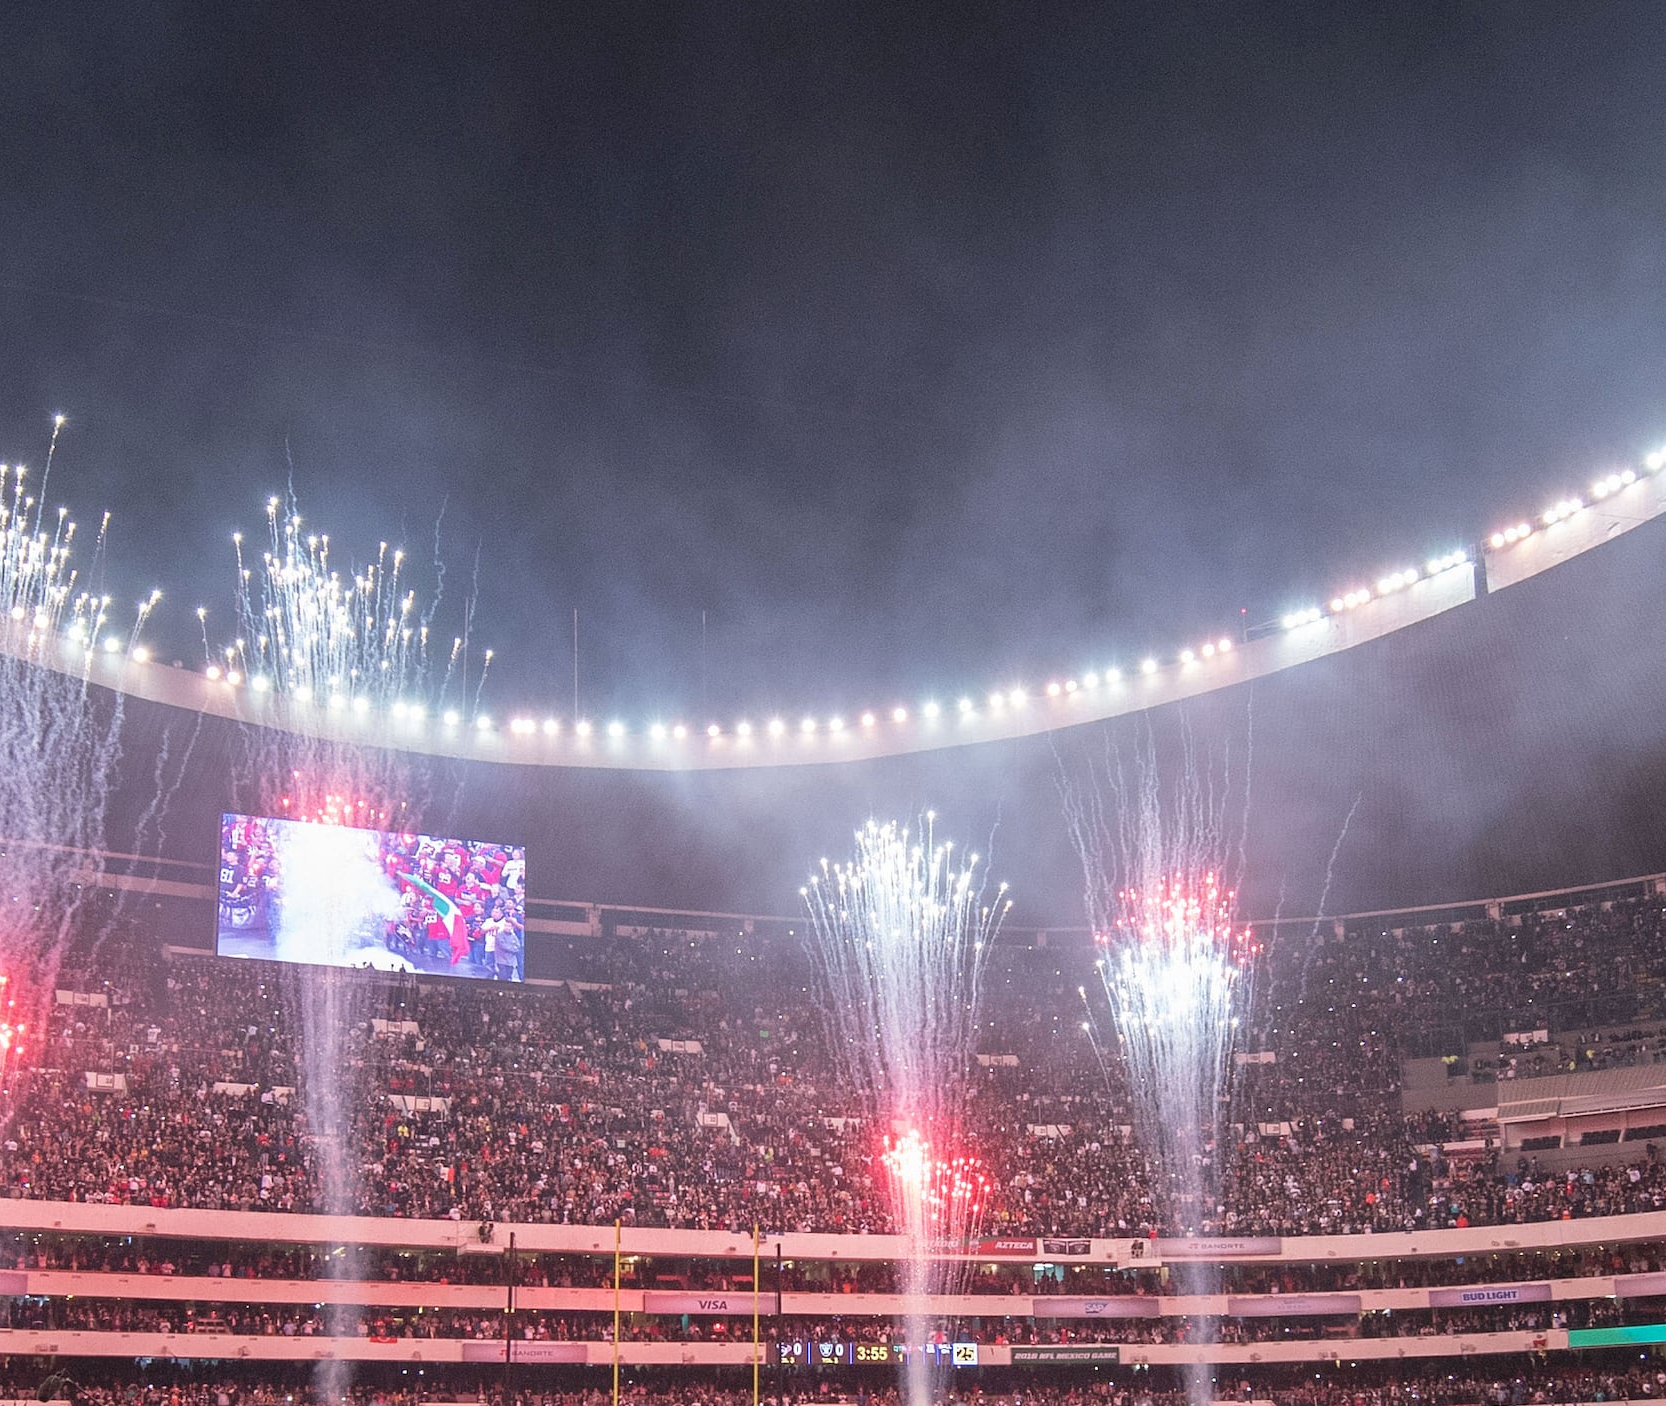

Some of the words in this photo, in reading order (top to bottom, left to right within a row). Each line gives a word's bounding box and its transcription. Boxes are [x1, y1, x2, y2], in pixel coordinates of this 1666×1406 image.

[994, 1240, 1033, 1250] AZTECA
[1200, 1242, 1246, 1250] BANORTE
[1462, 1292, 1485, 1302] BUD
[1486, 1290, 1518, 1300] LIGHT
[699, 1300, 728, 1310] VISA
[793, 1342, 802, 1356] 0
[835, 1343, 844, 1357] 0
[856, 1345, 888, 1361] 3:55
[956, 1346, 975, 1361] 25
[1056, 1352, 1090, 1360] MEXICO
